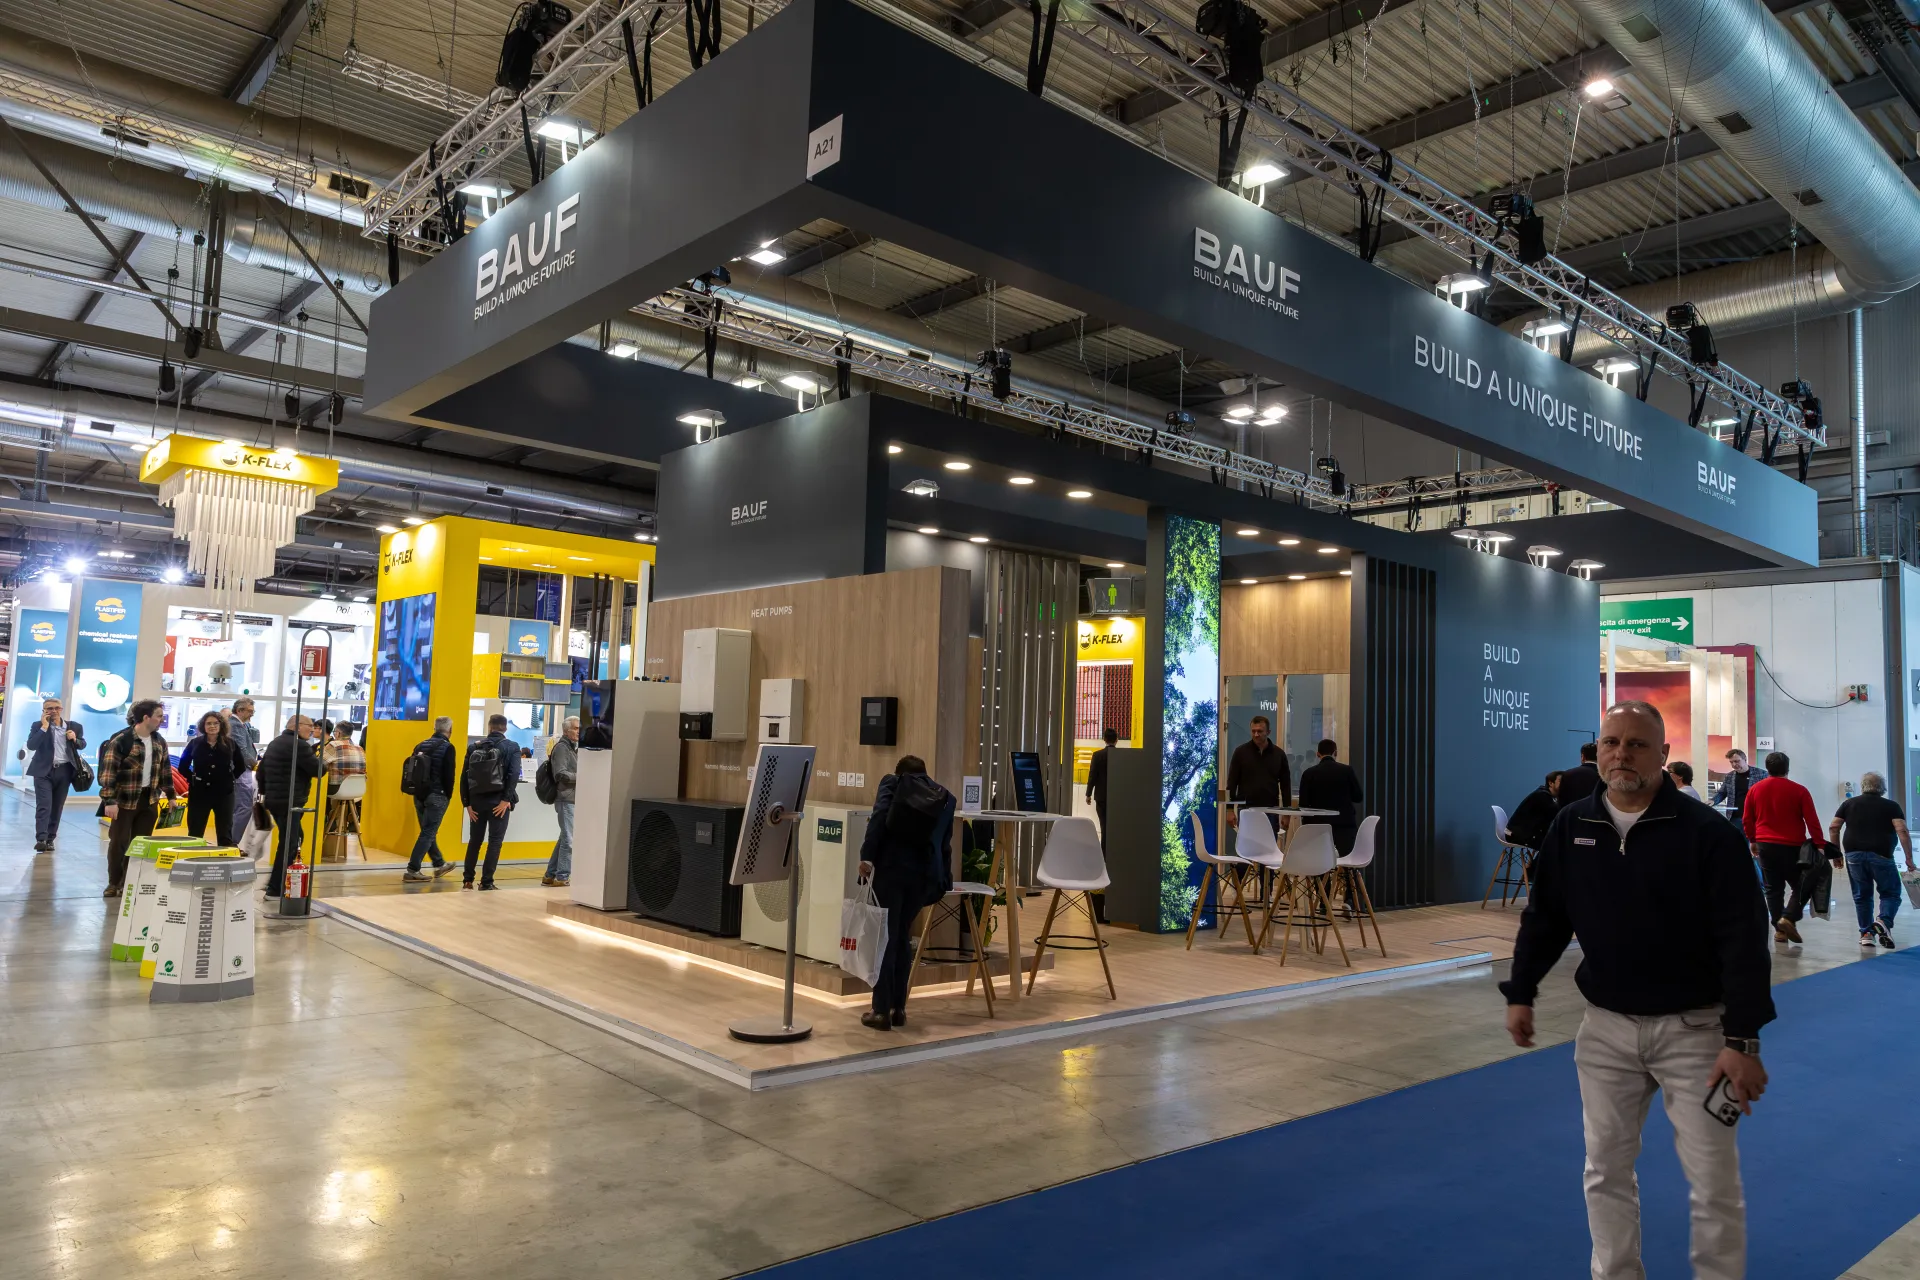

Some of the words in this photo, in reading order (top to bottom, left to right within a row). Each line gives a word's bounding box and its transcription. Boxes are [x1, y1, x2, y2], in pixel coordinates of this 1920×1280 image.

[814, 136, 834, 160] A21
[476, 192, 580, 300] BAUF
[1194, 226, 1301, 300] BAUF
[474, 296, 498, 320] BUILD
[498, 292, 505, 306] A
[506, 272, 539, 302] UNIQUE
[540, 250, 576, 282] FUTURE
[1193, 266, 1222, 286] BUILD
[1223, 280, 1230, 291] A
[1232, 283, 1266, 306] UNIQUE
[1267, 298, 1299, 320] FUTURE
[1414, 335, 1482, 389] BUILD
[1487, 370, 1502, 400] A
[1508, 377, 1577, 432] UNIQUE
[1583, 412, 1643, 462] FUTURE
[242, 454, 293, 472] K-FLEX
[1698, 460, 1736, 495] BAUF
[731, 500, 768, 520] BAUF
[392, 548, 414, 567] K-FLEX
[537, 589, 546, 601] 7
[94, 606, 127, 614] PLASTIFER
[751, 607, 768, 619] HEAT
[770, 605, 793, 617] PUMPS
[1600, 619, 1616, 627] scita
[1618, 618, 1625, 626] di
[1627, 617, 1671, 626] emergenza
[1637, 626, 1651, 634] exit
[78, 630, 108, 638] chemical
[92, 636, 124, 644] solutions
[1092, 634, 1123, 645] K-FLEX
[1484, 642, 1520, 664] BUILD
[1484, 664, 1493, 682] A
[1484, 686, 1530, 710] UNIQUE
[1484, 710, 1530, 731] FUTURE
[818, 825, 842, 836] BAUF
[122, 884, 134, 918] PAPER
[195, 887, 216, 979] INDIFFERENZIATO
[840, 936, 856, 951] ABB
